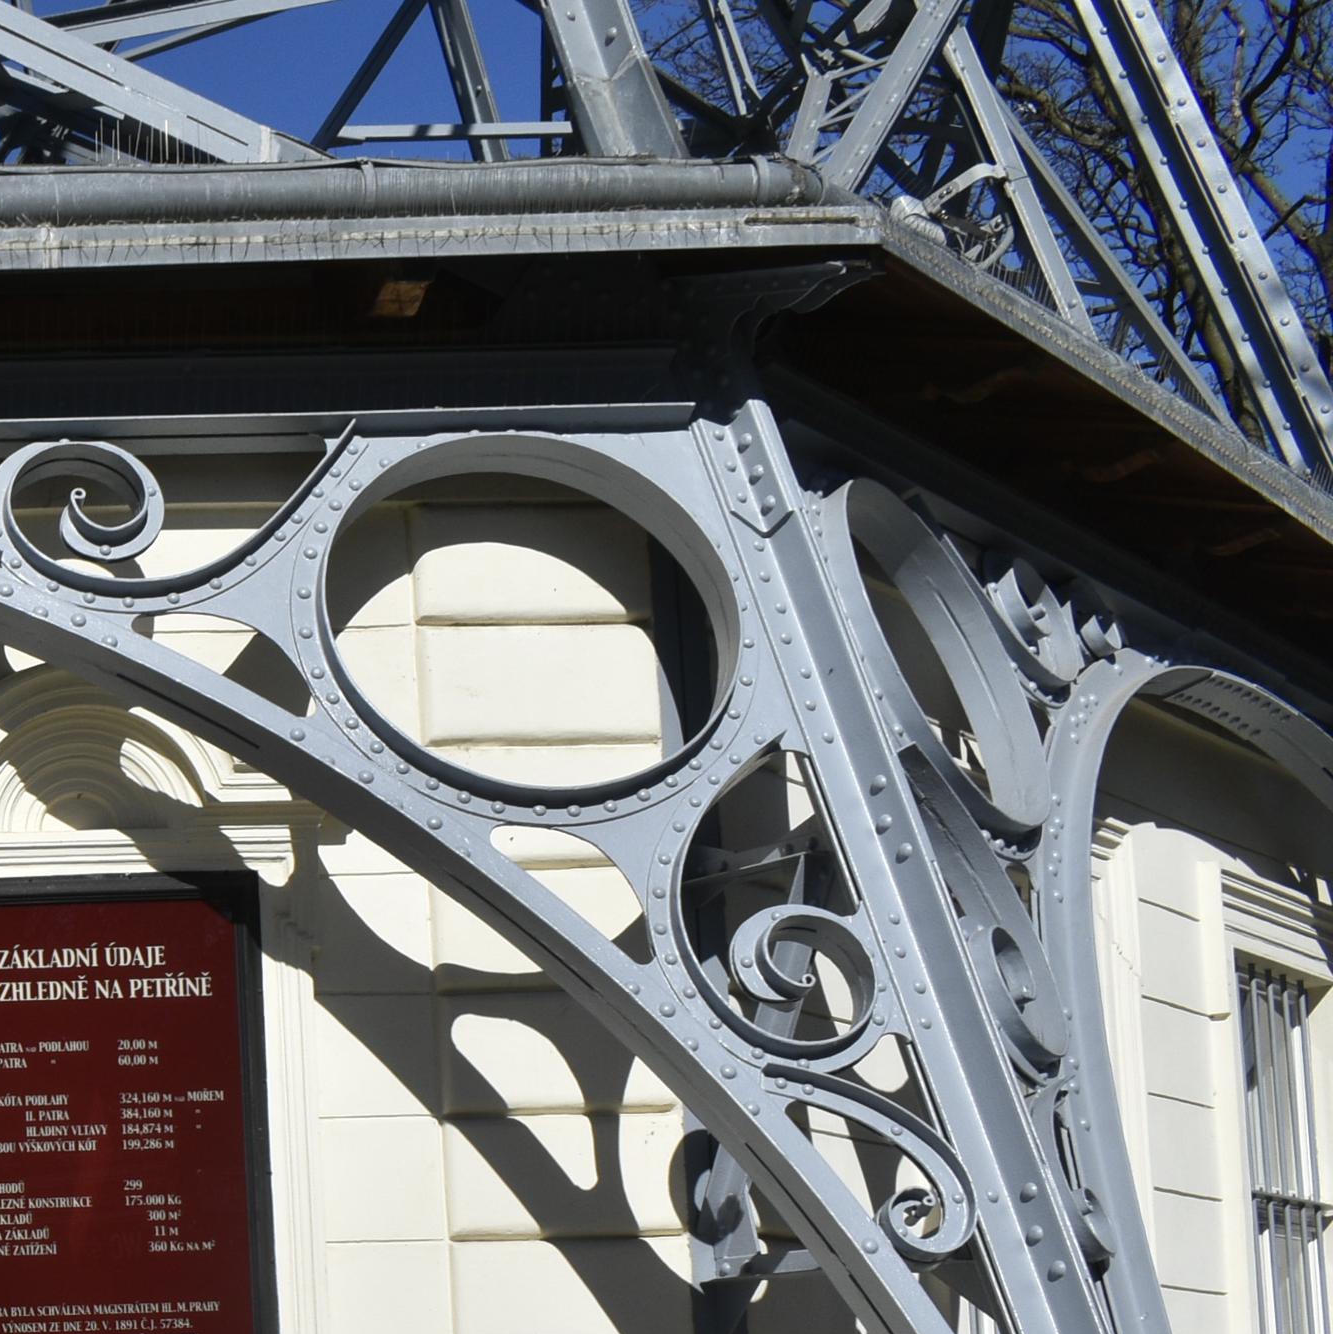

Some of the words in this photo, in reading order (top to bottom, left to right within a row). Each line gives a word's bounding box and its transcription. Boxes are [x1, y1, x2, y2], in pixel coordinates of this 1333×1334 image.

[105, 942, 166, 968] ÚDAJE
[95, 979, 123, 999] NA
[129, 971, 213, 998] PETŘÍNĚ
[39, 1040, 90, 1053] PODLAHOU
[117, 1039, 146, 1051] 20,00
[118, 1055, 147, 1066] 60,00
[25, 1095, 69, 1106] PODLAHY
[119, 1092, 160, 1104] 324,160
[187, 1088, 224, 1101] MOŘEM
[39, 1110, 70, 1121] PATRA
[120, 1108, 161, 1120] 384,160
[26, 1125, 69, 1137] HLADINY
[71, 1124, 108, 1136] VLTAVY
[121, 1123, 162, 1135] 184,874
[18, 1138, 75, 1152] VÝŠKOVÝCH
[78, 1137, 97, 1151] KÓT
[122, 1139, 162, 1151] 199,286
[123, 1179, 143, 1190] 299
[28, 1196, 93, 1209] KONSTRUKCE
[125, 1195, 165, 1206] 175.000
[147, 1210, 166, 1221] 300
[5, 1227, 49, 1240] ZÁKLADŮ
[155, 1225, 166, 1236] 11
[13, 1241, 57, 1256] ZATÍŽENÍ
[148, 1241, 167, 1252] 360
[10, 1306, 35, 1317] BYLA
[37, 1303, 91, 1316] SCHVÁLENA
[93, 1301, 159, 1315] MAGISTRÁTEM
[189, 1301, 220, 1312] PRAHY
[2, 1320, 46, 1333] VÝNOSEM
[49, 1322, 60, 1332] ZE
[63, 1321, 82, 1331] DNE
[85, 1321, 100, 1331] 20.
[102, 1321, 112, 1330] V.
[115, 1319, 139, 1330] 1891
[160, 1318, 193, 1329] 57384.
